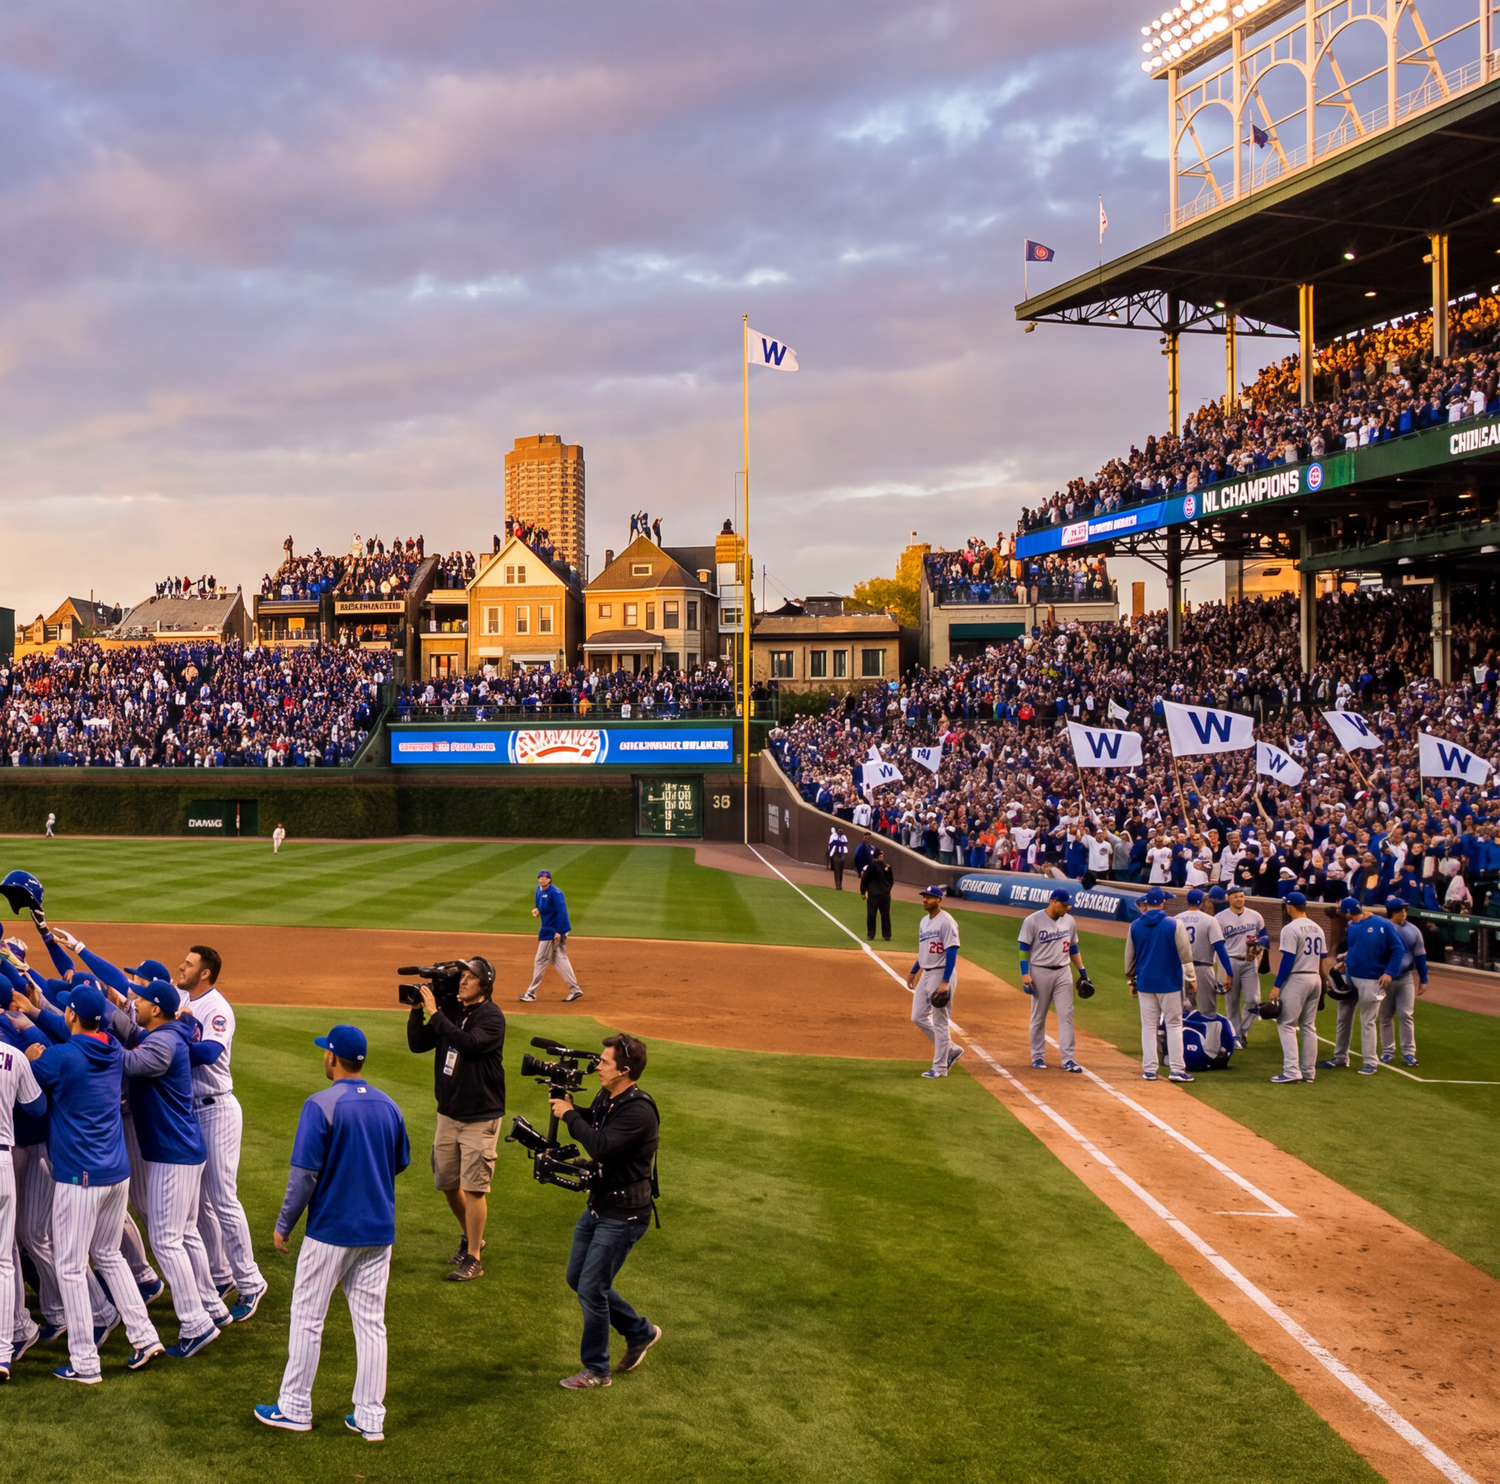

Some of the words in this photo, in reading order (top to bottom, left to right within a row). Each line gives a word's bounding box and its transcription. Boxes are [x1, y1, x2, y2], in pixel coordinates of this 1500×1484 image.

[761, 337, 788, 367] W
[1202, 489, 1219, 514] NL
[1220, 469, 1300, 510] CHAMPIONS
[1186, 710, 1233, 745] W
[1084, 731, 1123, 760] W
[1265, 746, 1289, 774] W
[1436, 741, 1473, 774] W
[878, 764, 894, 779] W
